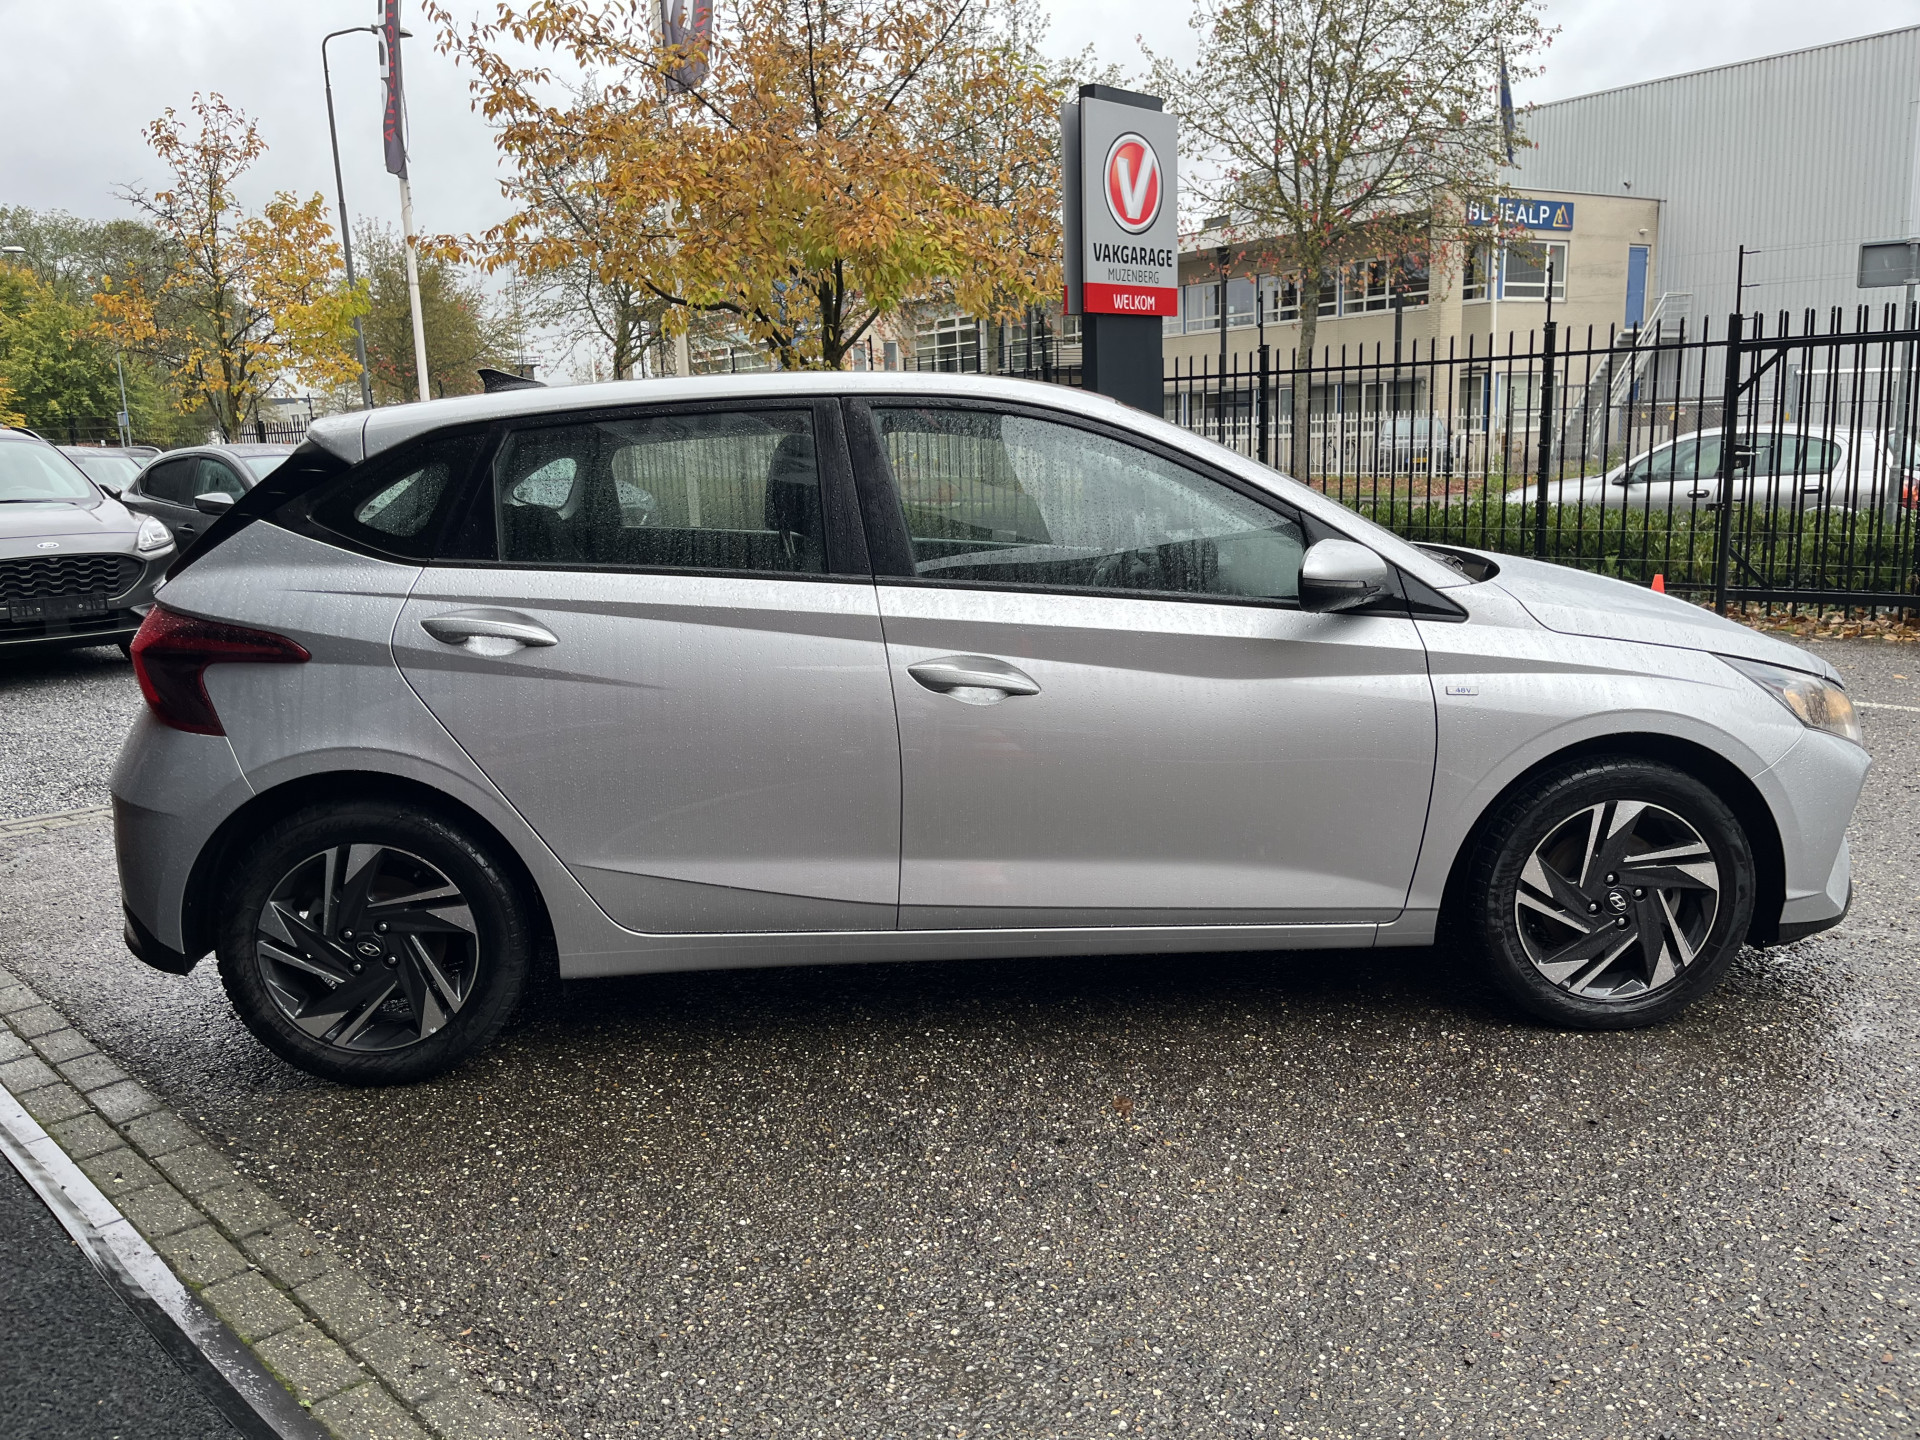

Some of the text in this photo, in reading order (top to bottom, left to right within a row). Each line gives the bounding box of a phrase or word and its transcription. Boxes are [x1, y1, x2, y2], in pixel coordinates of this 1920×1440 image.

[1093, 242, 1173, 267] VAKGARAGE
[1108, 268, 1160, 284] MUZENBERG
[1113, 294, 1155, 311] WELKOM
